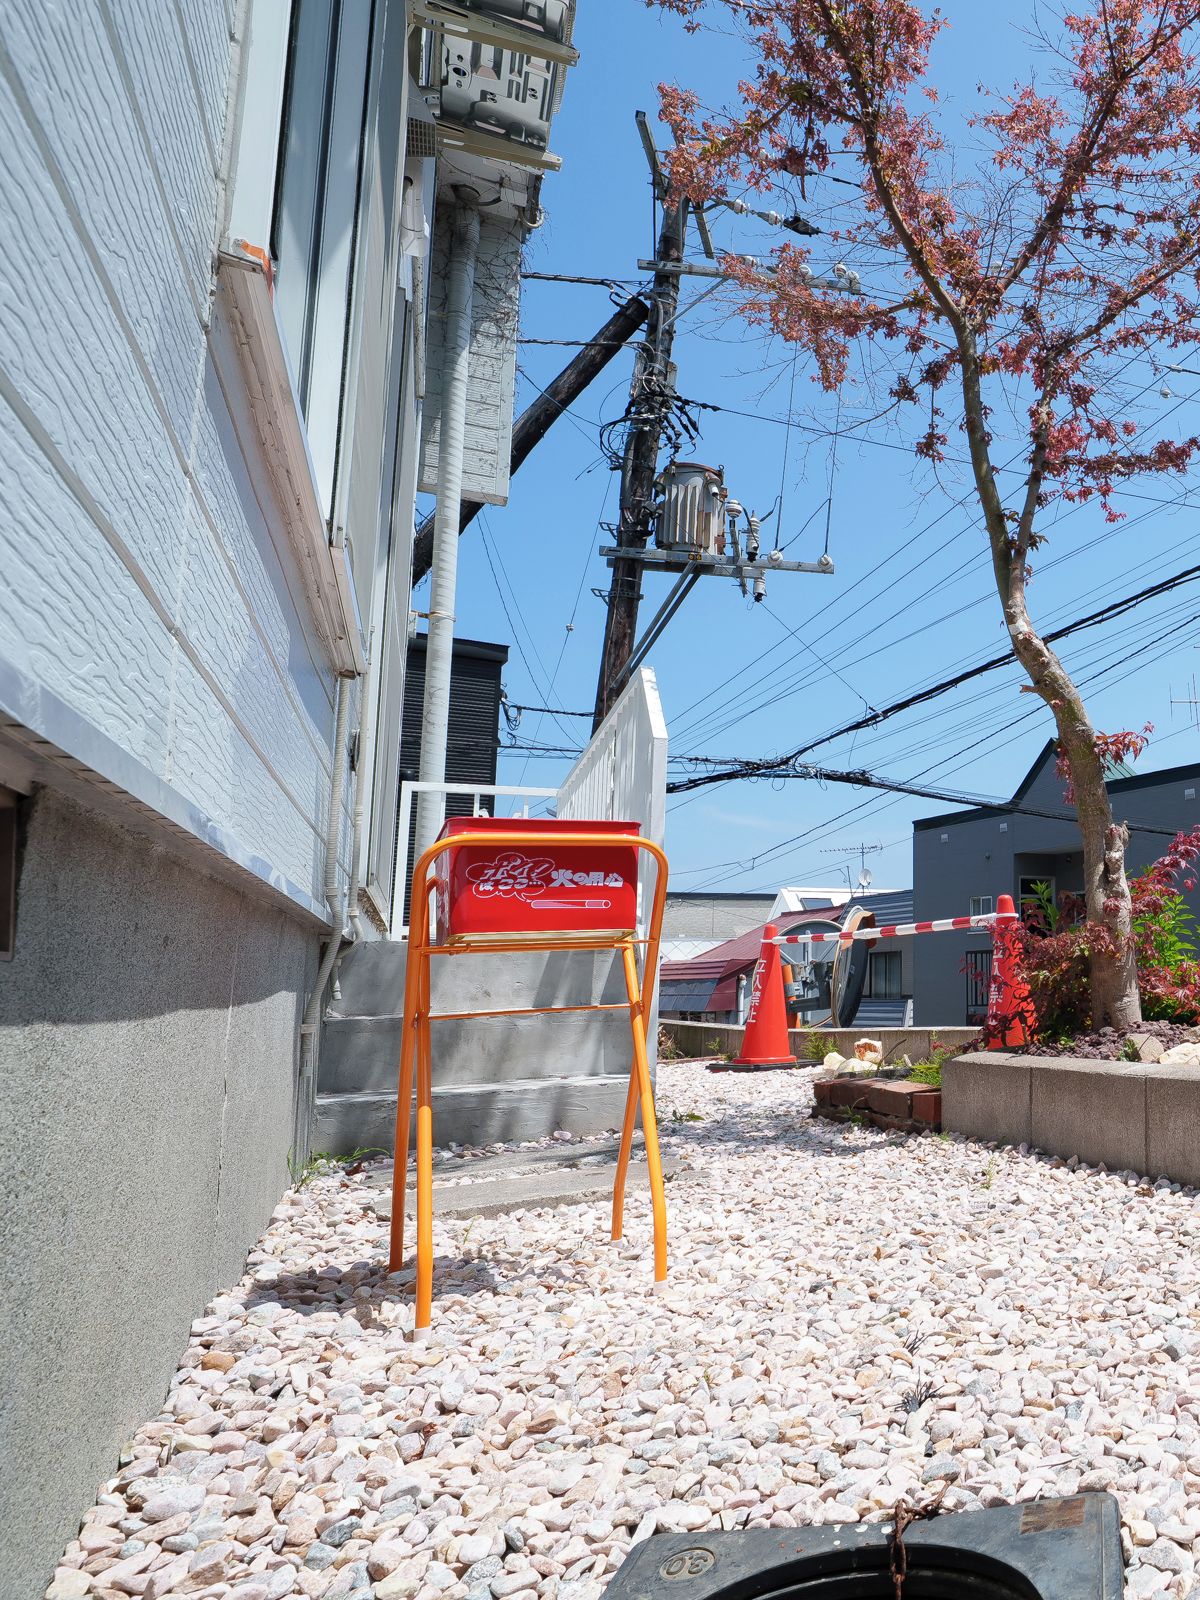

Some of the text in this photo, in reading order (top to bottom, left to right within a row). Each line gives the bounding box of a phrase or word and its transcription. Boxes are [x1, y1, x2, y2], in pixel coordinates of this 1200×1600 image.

[550, 869, 624, 888] 火の用心
[747, 959, 767, 1023] 立入禁止
